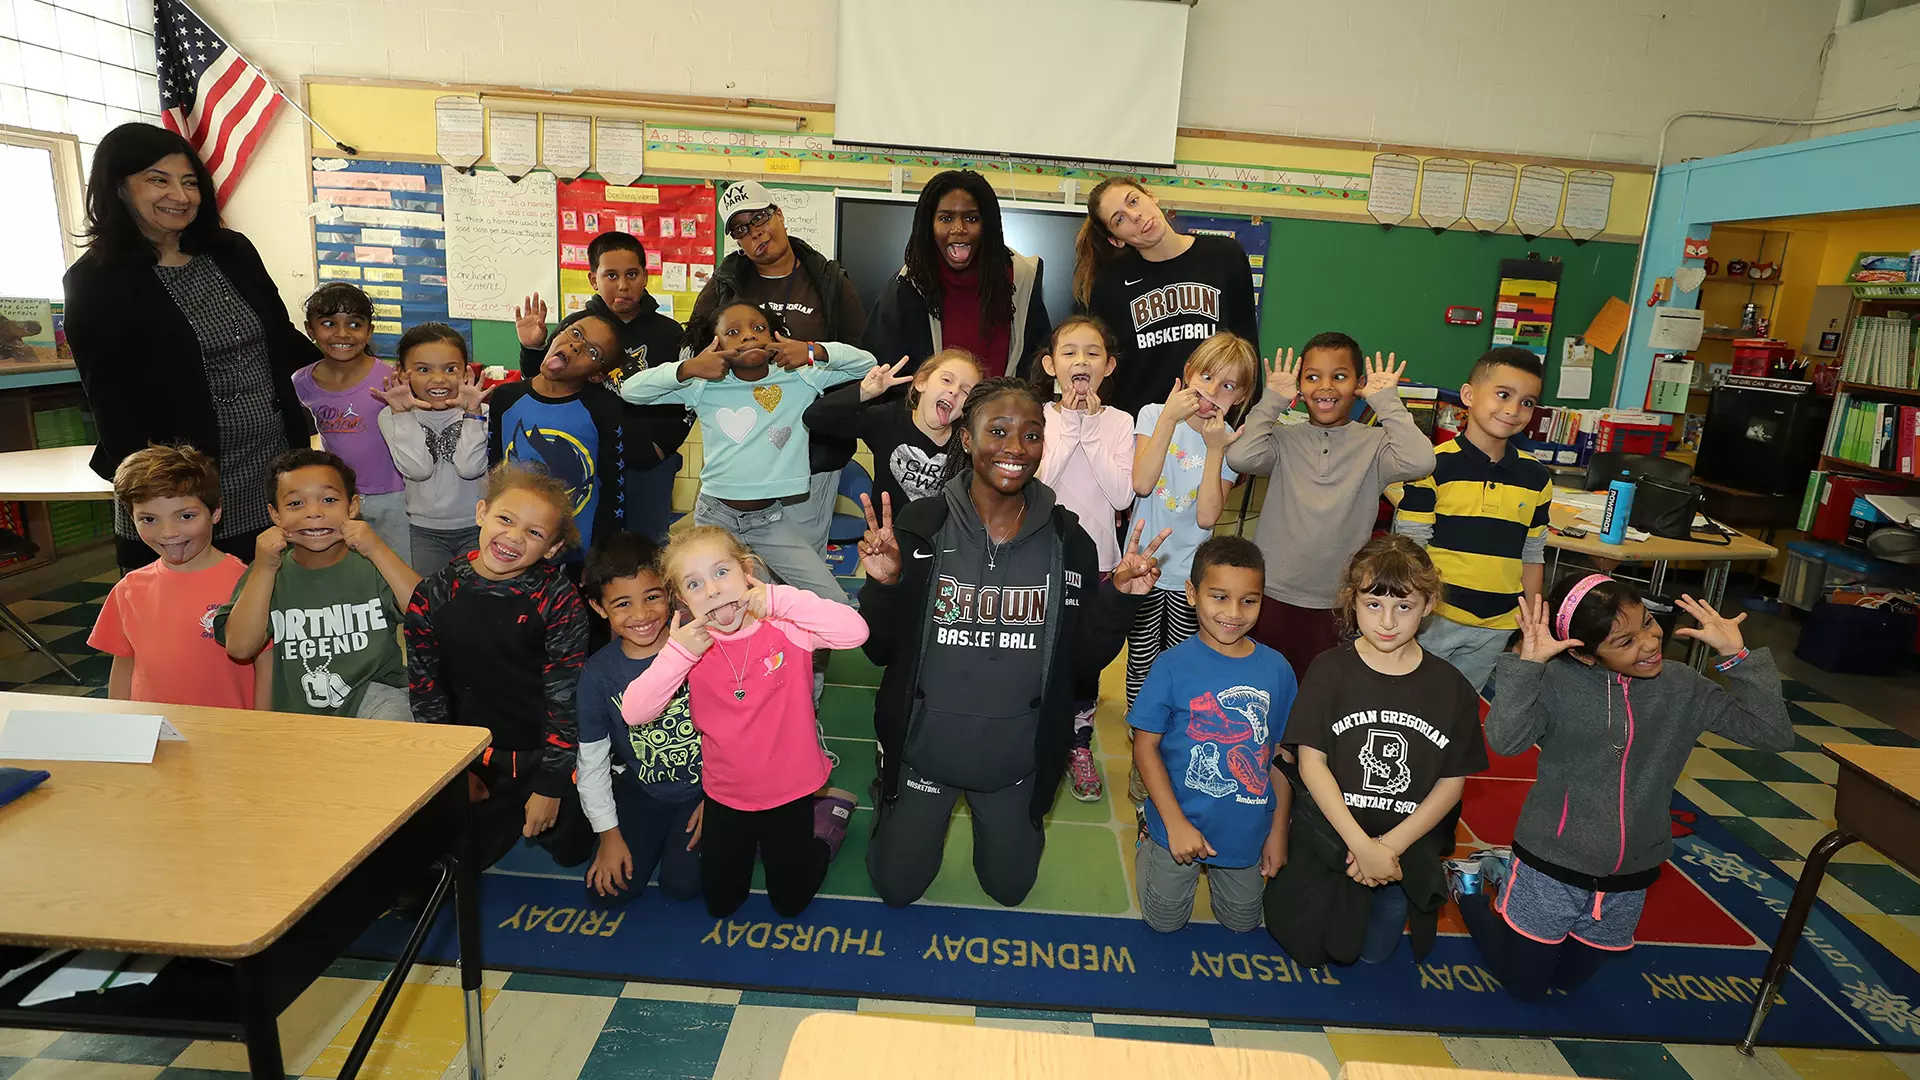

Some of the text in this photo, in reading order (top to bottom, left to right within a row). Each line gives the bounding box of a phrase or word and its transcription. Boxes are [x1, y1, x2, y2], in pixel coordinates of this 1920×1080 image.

[650, 129, 668, 142] Aa
[678, 130, 694, 143] Bb
[702, 132, 718, 144] Cc
[729, 133, 746, 146] Dd
[752, 134, 768, 147] Ee
[780, 136, 794, 148] Ff
[804, 136, 822, 154] Gg
[1176, 164, 1190, 177] Uu
[1206, 166, 1219, 178] Vv
[1234, 168, 1258, 182] Ww
[1276, 172, 1292, 184] Xx
[1313, 174, 1324, 190] Yy
[1343, 176, 1359, 190] Zz
[607, 190, 658, 202] Spelling Words
[722, 185, 745, 204] IVY
[725, 193, 749, 211] PARK
[786, 211, 818, 224] partner!
[450, 268, 496, 280] Conclusion
[462, 280, 501, 292] Sentence
[458, 300, 478, 311] These
[481, 303, 500, 312] are
[1130, 281, 1221, 332] BROWN
[1602, 490, 1616, 533] POWERADE
[933, 574, 1050, 625] BROWN
[282, 632, 369, 660] EGEND
[1331, 710, 1450, 750] VARTAN GREGORIAN
[1358, 728, 1412, 795] B
[906, 779, 941, 794] BASKETBALL
[1236, 794, 1268, 805] Timberland
[498, 904, 626, 938] FRIDAY
[700, 919, 886, 957] THURSDAY
[922, 933, 1137, 974] WEDNESDAY
